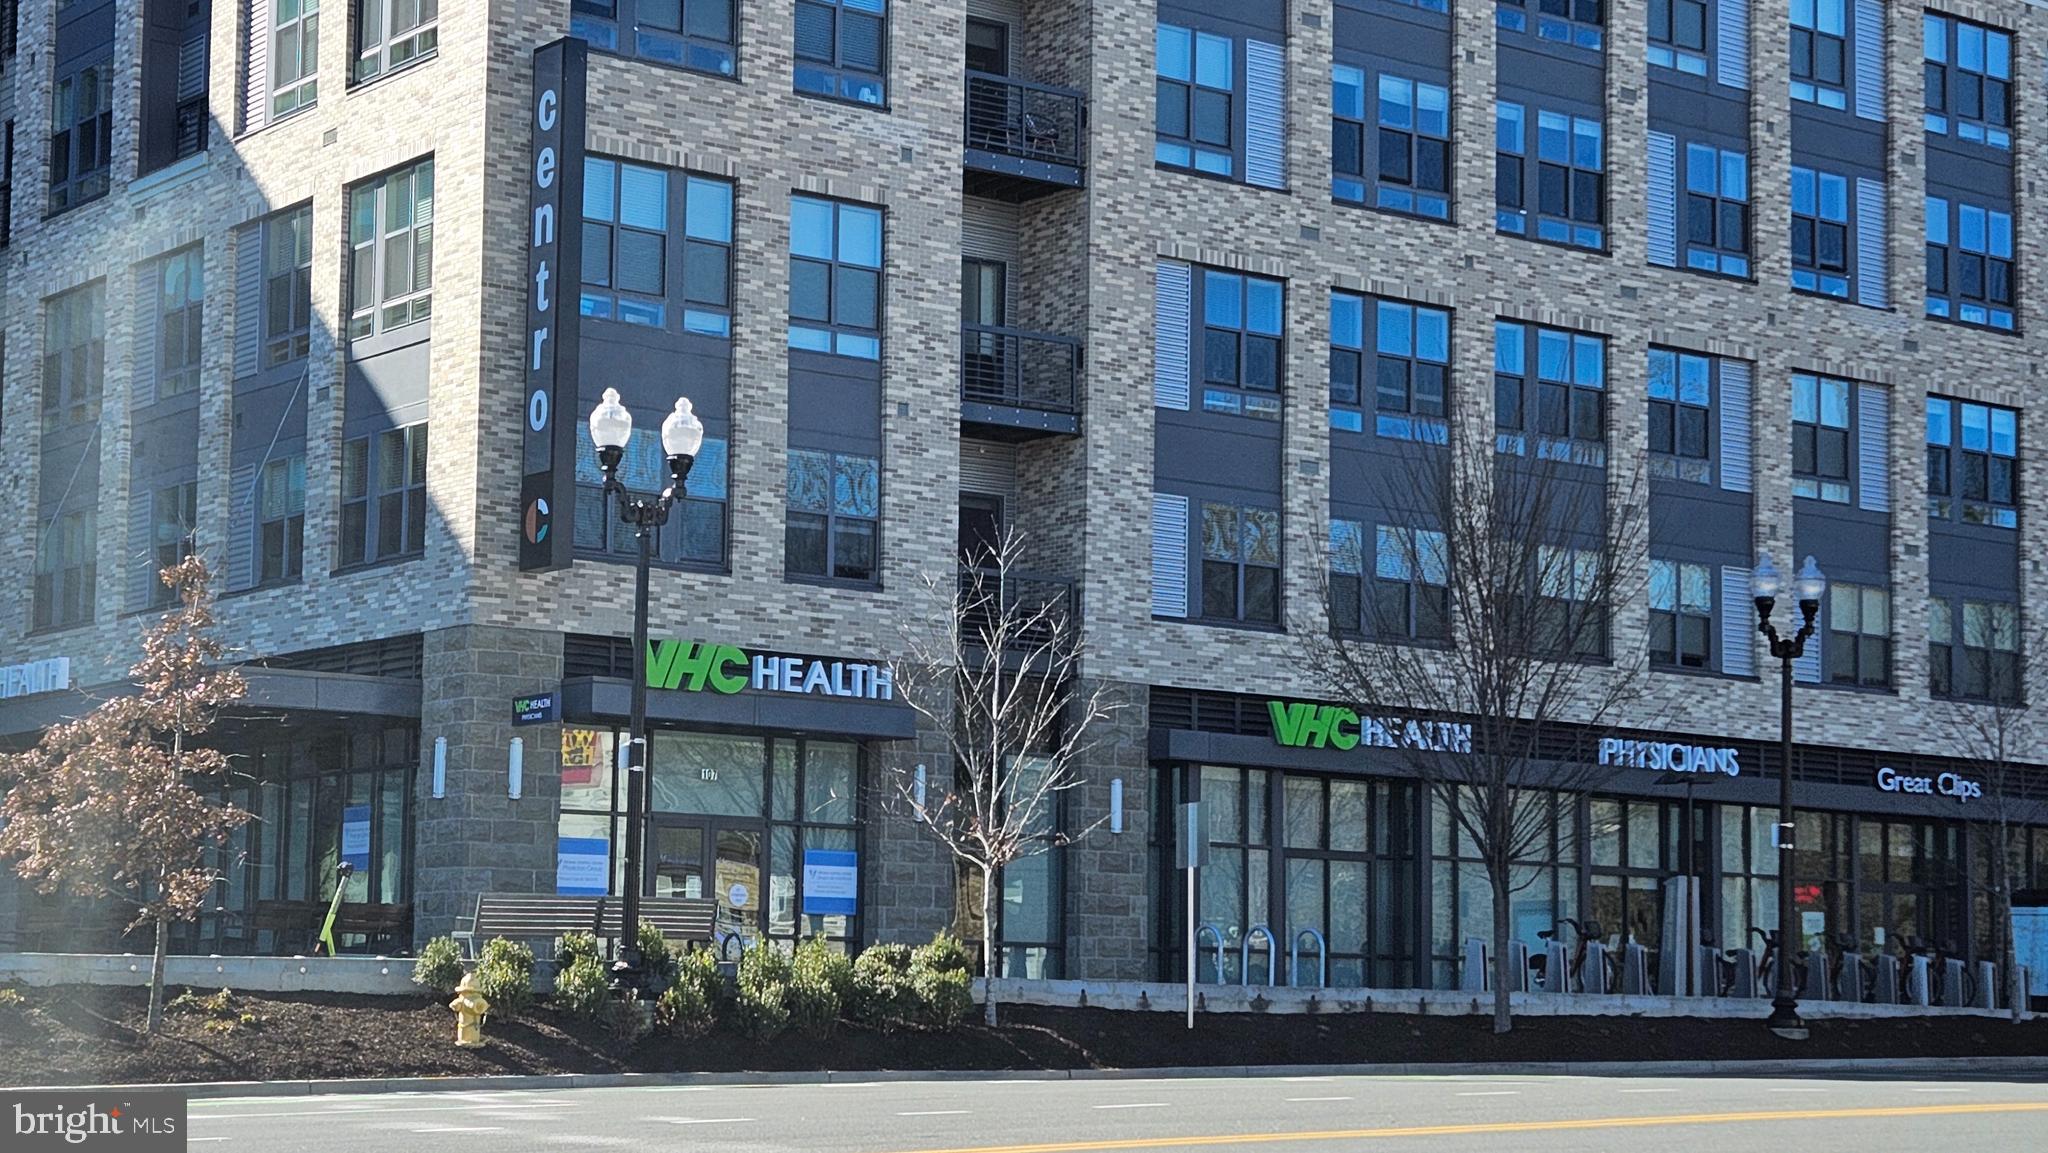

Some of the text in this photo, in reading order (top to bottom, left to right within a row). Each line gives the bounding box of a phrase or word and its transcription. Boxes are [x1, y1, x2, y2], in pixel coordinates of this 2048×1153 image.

[529, 89, 556, 431] centro
[646, 639, 893, 700] VHC HEALTH
[1267, 701, 1471, 753] VHC HEALTH
[701, 768, 718, 781] 107
[1598, 737, 1740, 777] PHYSICIANS
[1877, 767, 1982, 803] Great Clips
